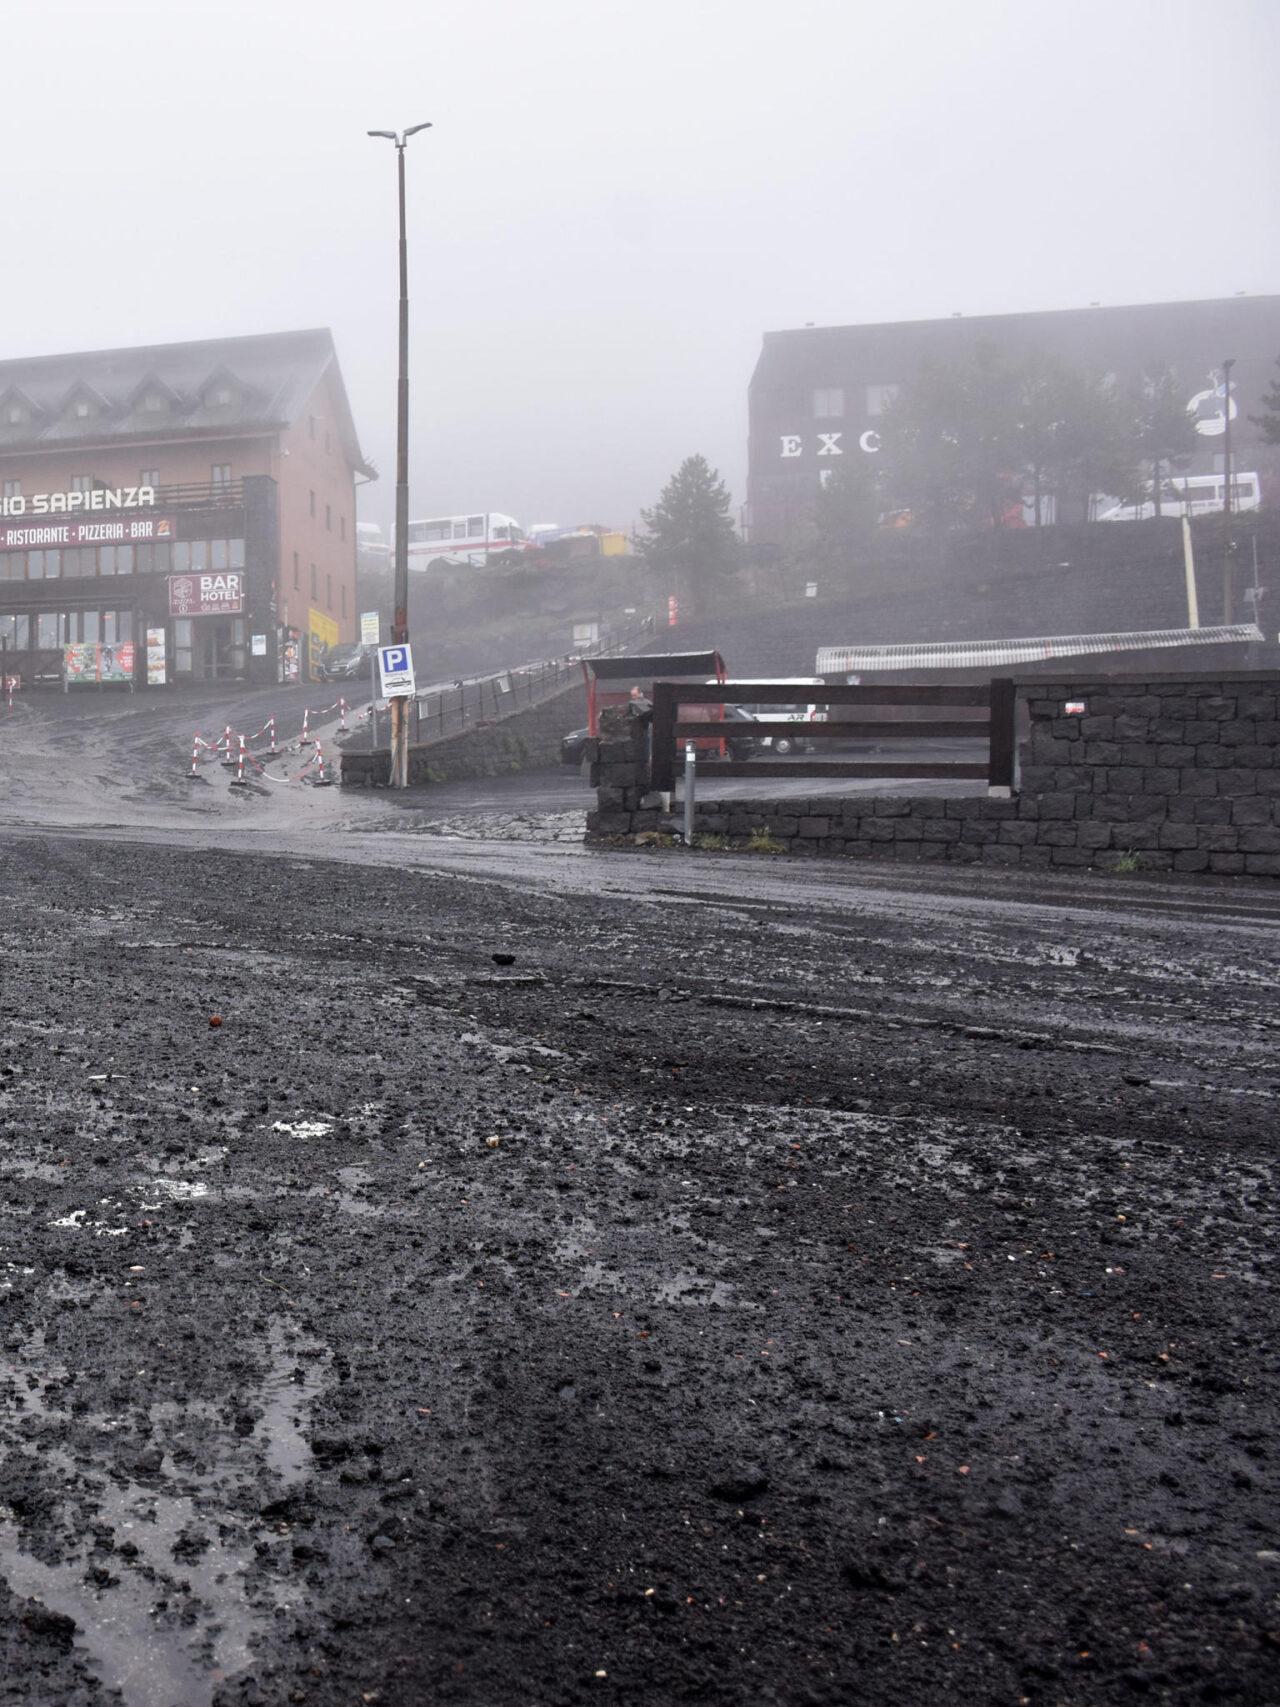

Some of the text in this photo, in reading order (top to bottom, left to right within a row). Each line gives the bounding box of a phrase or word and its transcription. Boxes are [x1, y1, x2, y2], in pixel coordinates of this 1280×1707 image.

[32, 486, 155, 514] SAPIENZA
[7, 527, 69, 546] RISTORANTE
[78, 523, 124, 541] PIZZERIA
[131, 521, 153, 537] BAR
[201, 575, 238, 590] BAR
[201, 591, 239, 601] HOTEL
[387, 650, 403, 671] P
